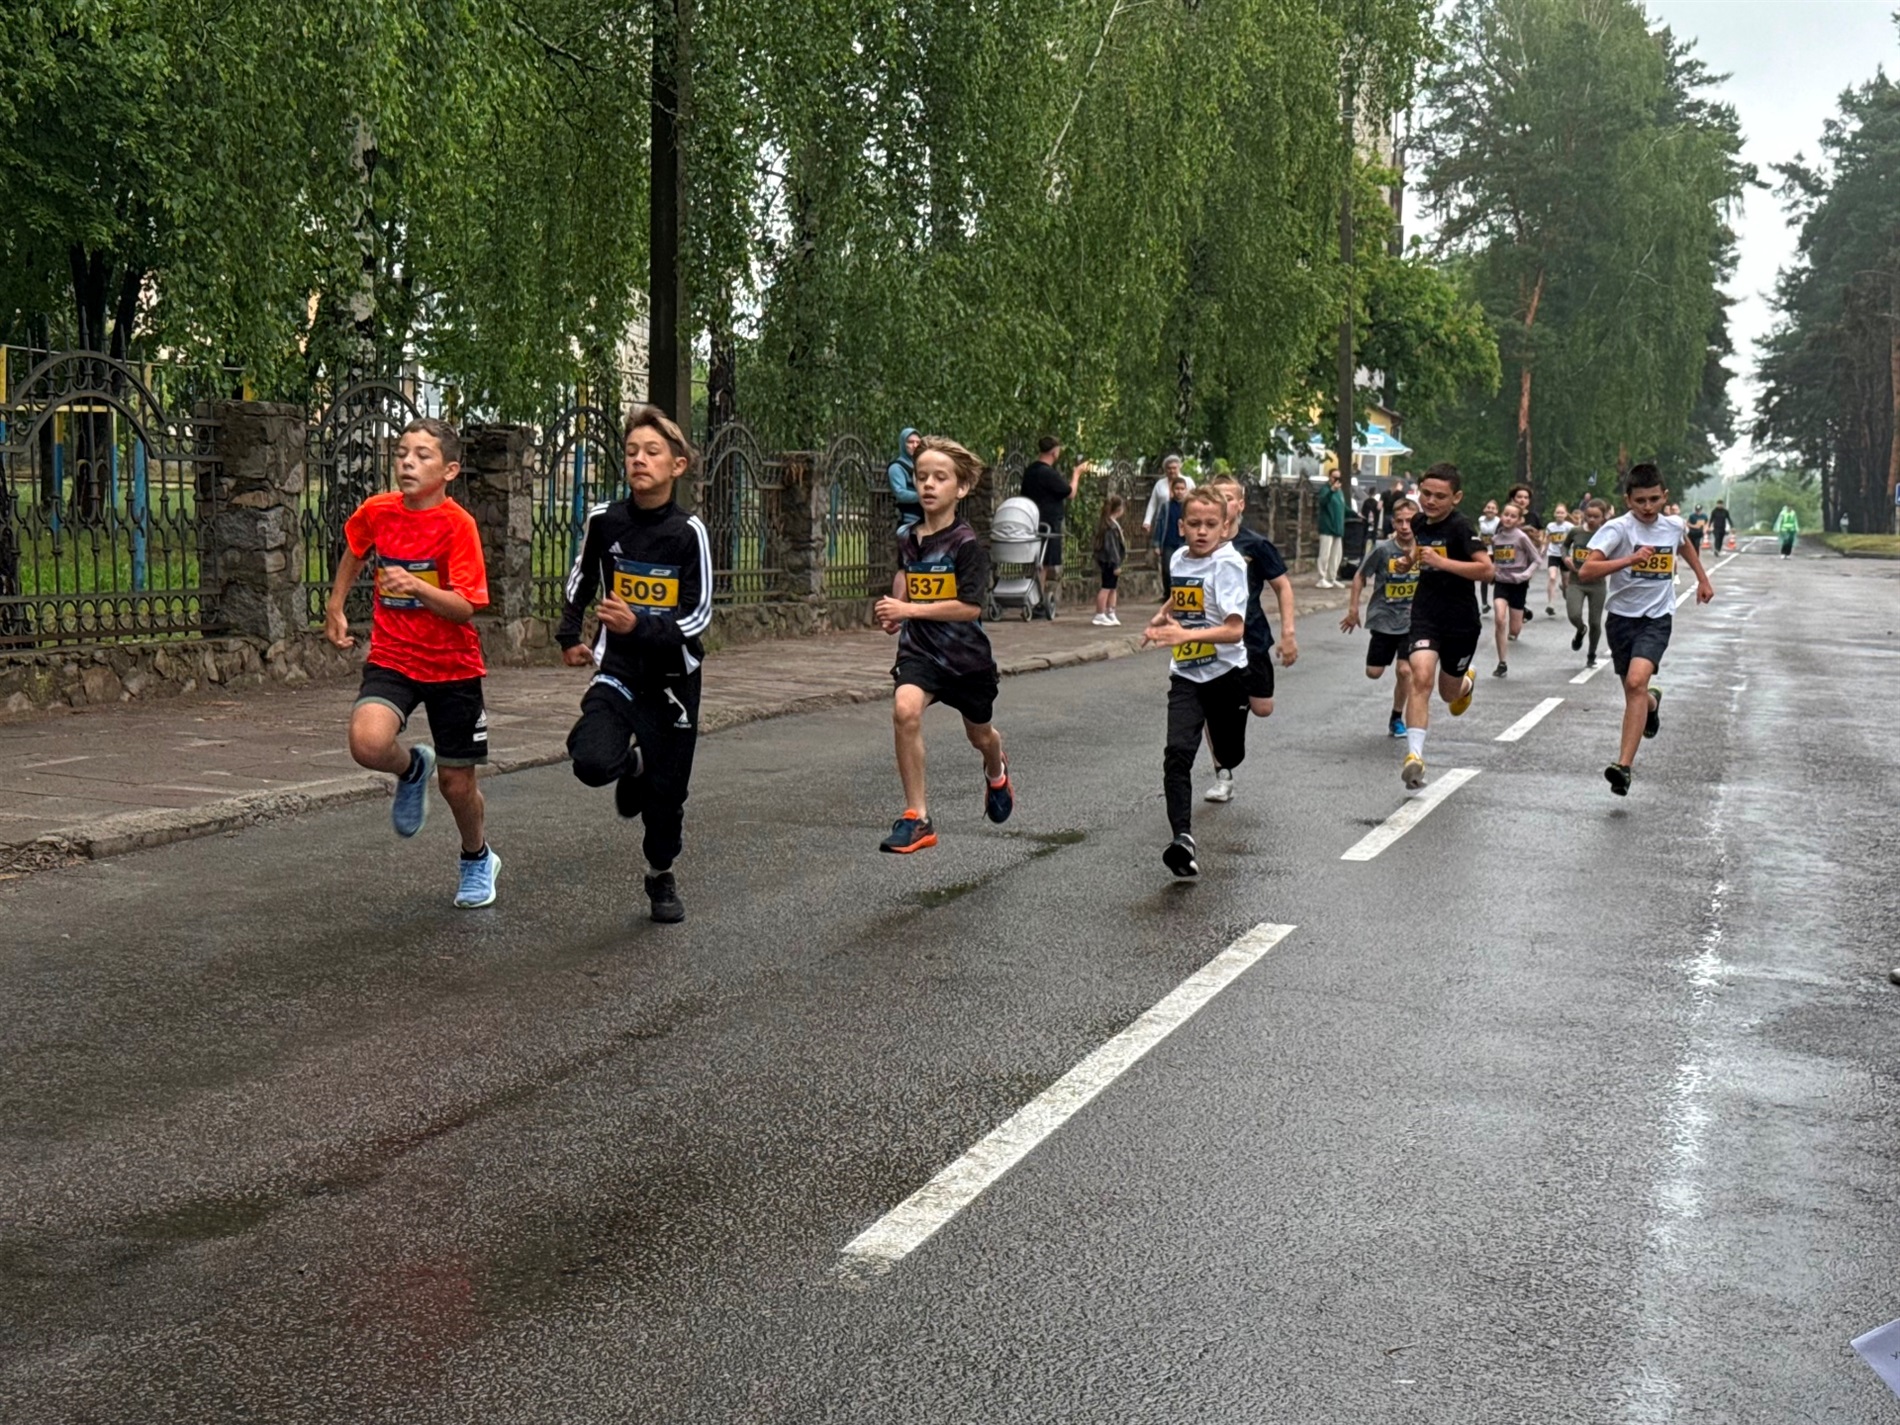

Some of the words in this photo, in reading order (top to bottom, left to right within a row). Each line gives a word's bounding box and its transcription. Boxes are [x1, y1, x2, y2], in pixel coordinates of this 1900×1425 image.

[620, 577, 667, 602] 509
[910, 577, 945, 596] 537
[1389, 585, 1414, 596] 703
